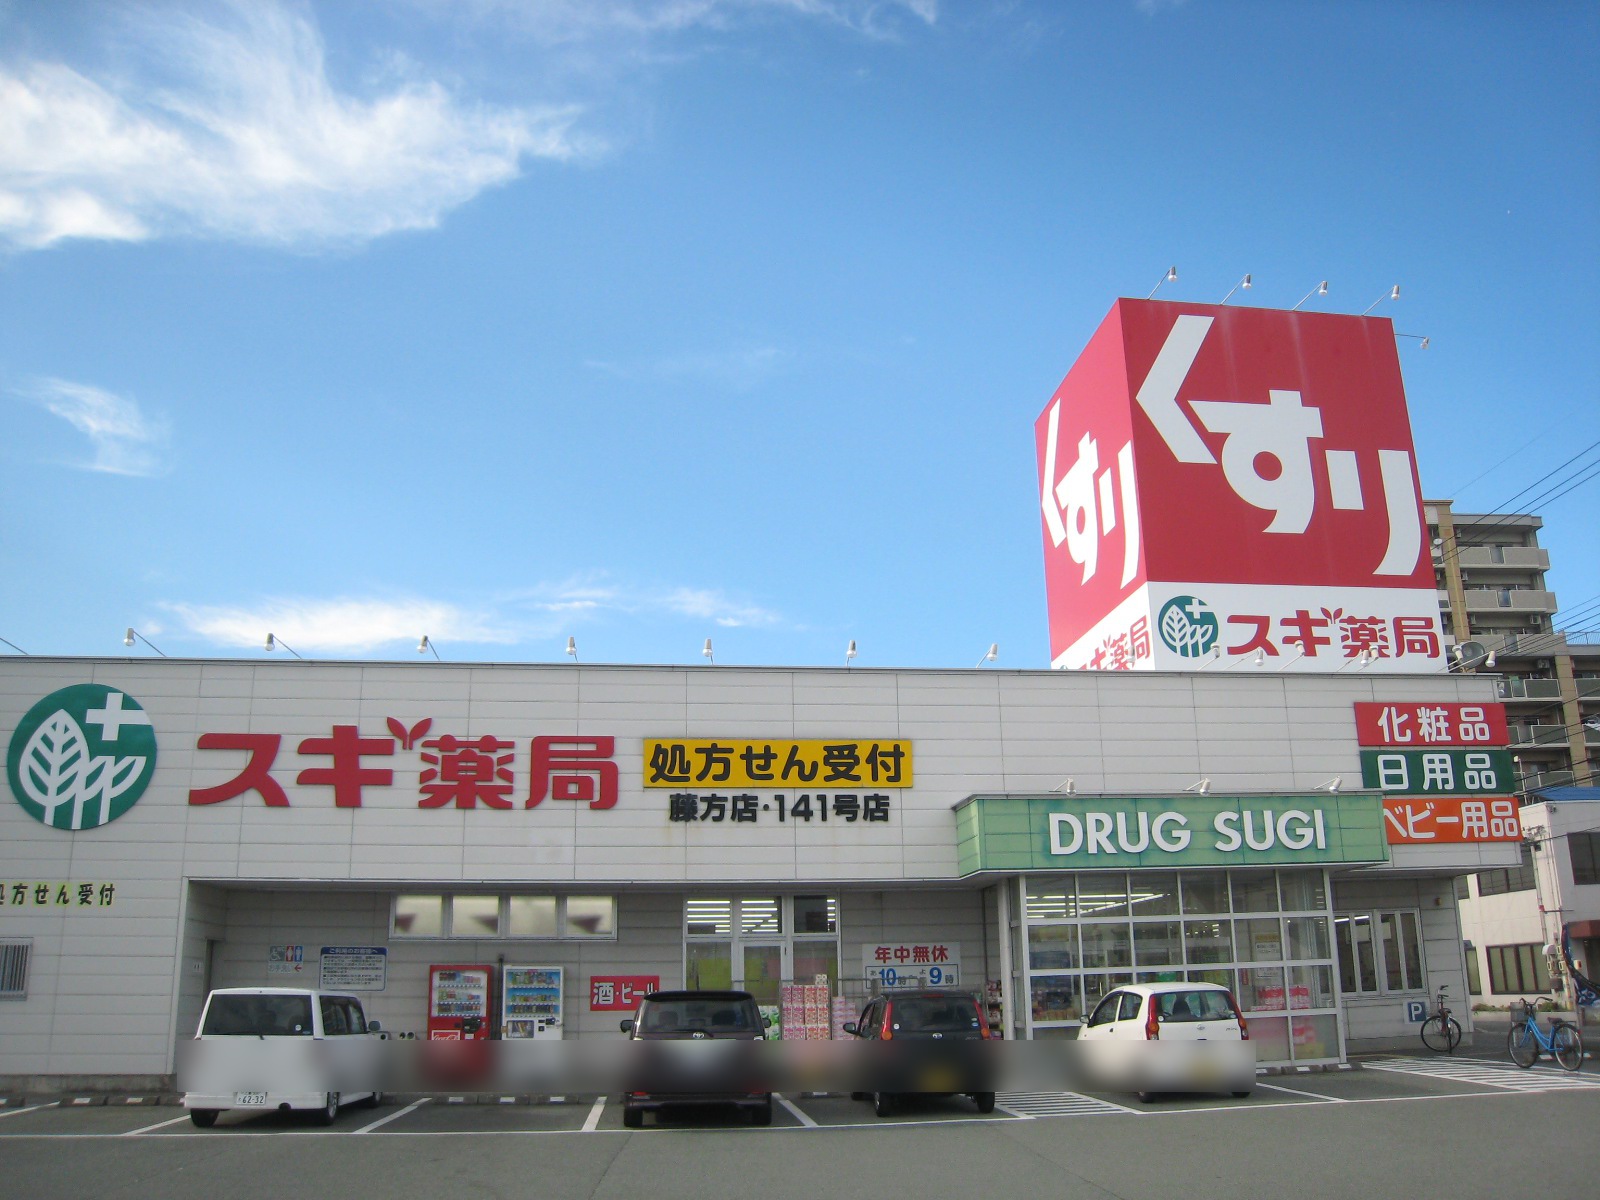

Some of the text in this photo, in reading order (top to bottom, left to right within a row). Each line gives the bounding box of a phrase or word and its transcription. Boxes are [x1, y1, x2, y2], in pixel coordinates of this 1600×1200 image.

[1136, 314, 1421, 575] くすり
[1041, 397, 1140, 589] くすり
[1079, 614, 1150, 670] ギ薬局
[1227, 607, 1440, 658] スギ薬局
[1377, 707, 1490, 742] 化粧品
[188, 717, 618, 810] スギ薬局
[649, 743, 905, 782] 処方せん受付
[1377, 754, 1497, 790] 日用品
[1049, 809, 1326, 855] DRUG SUGI
[1384, 801, 1519, 838] ベビー用品
[875, 945, 949, 964] 年中無休
[1411, 1004, 1423, 1020] P
